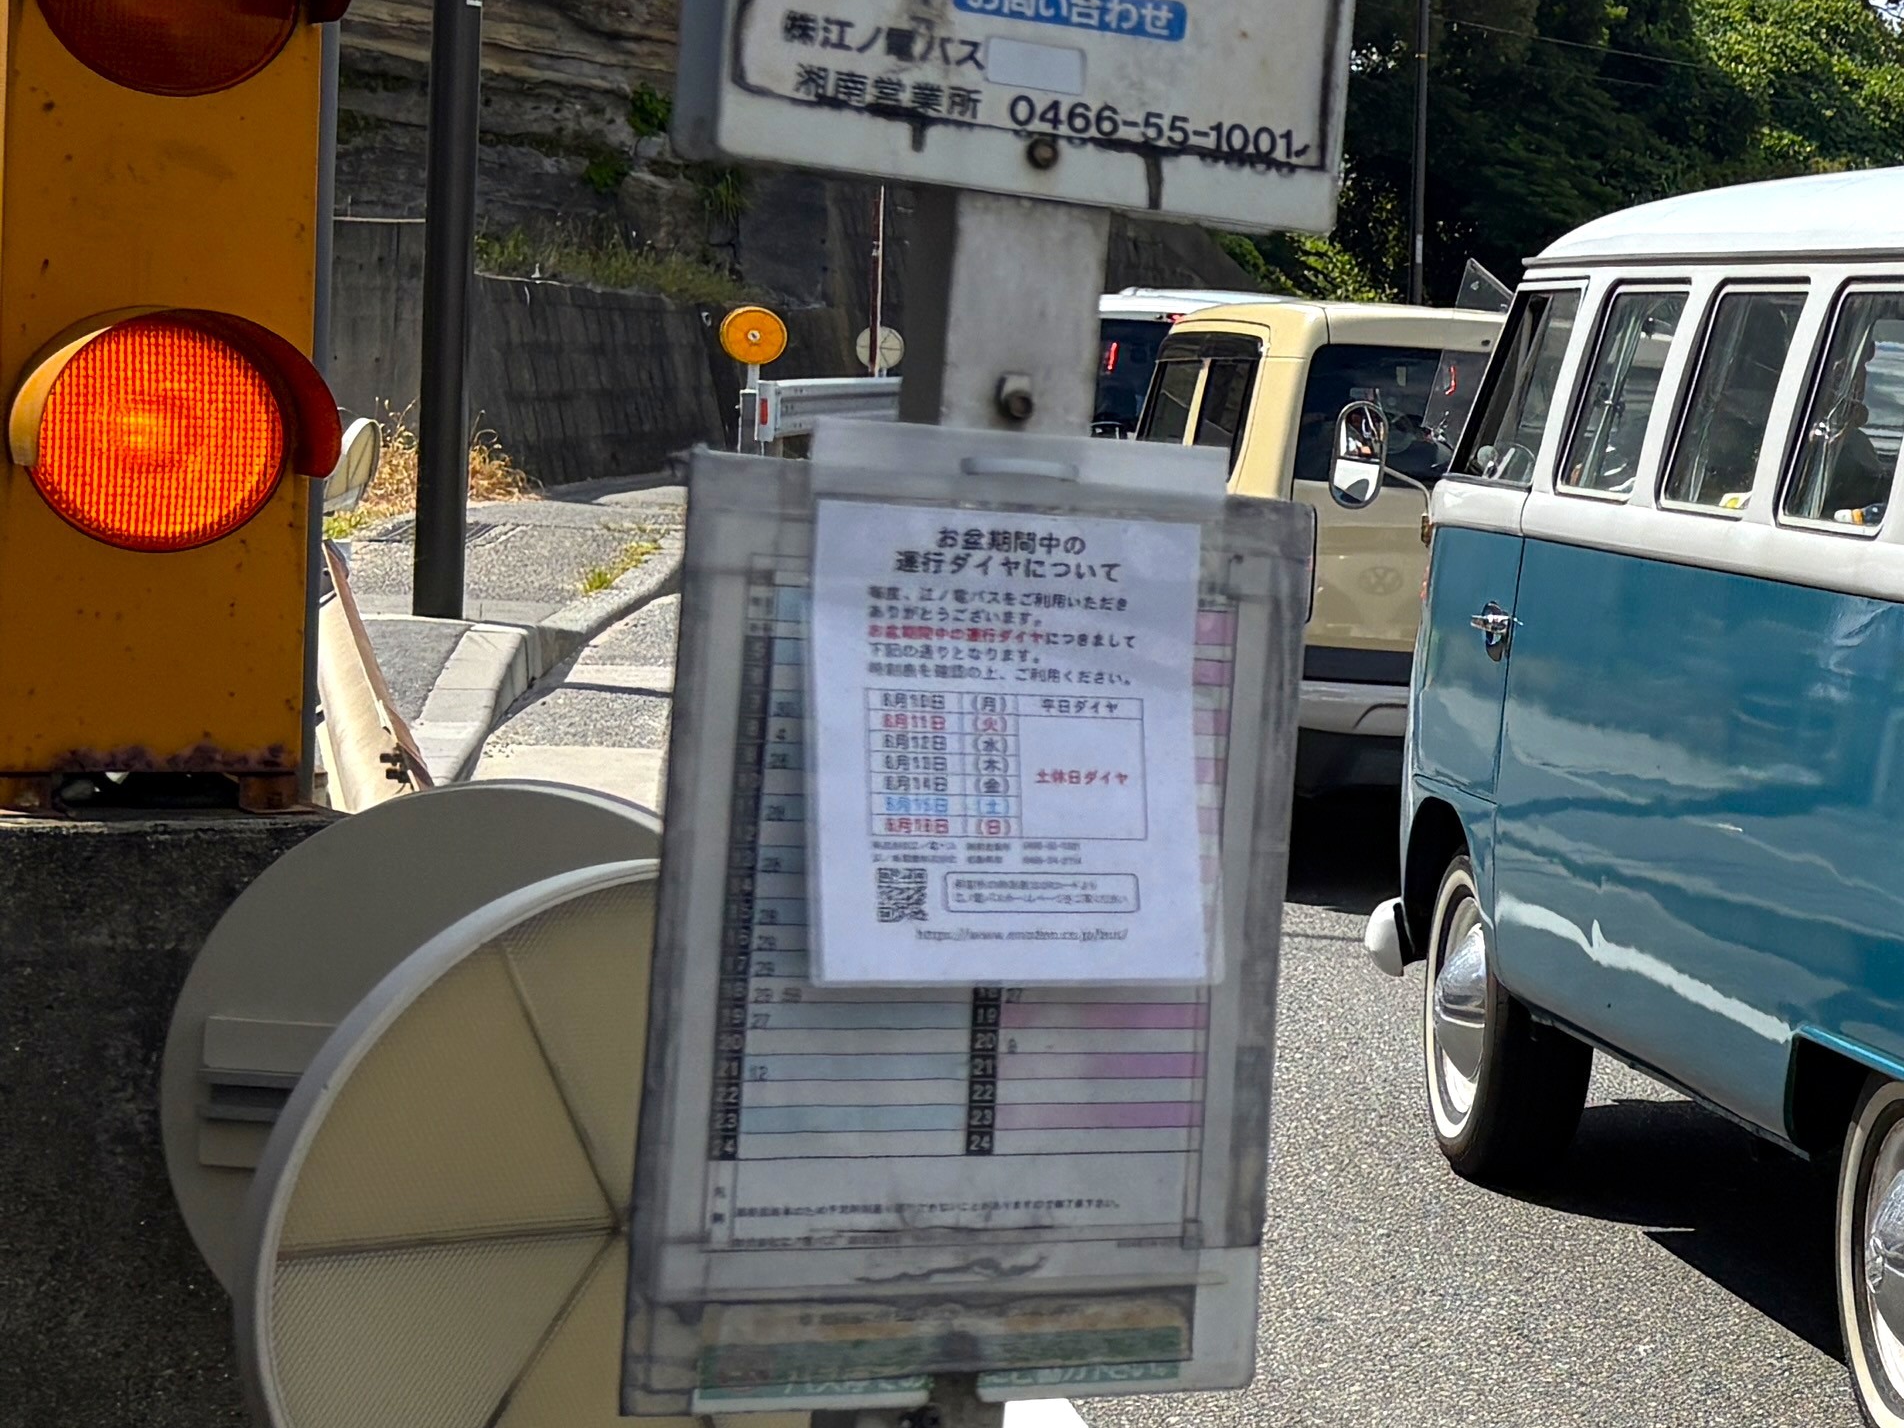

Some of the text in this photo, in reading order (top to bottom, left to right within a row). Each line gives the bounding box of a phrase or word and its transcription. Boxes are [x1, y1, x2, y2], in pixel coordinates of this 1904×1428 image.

[1008, 93, 1296, 160] 0466-55-1001
[936, 526, 1087, 556] お盆期間中の
[895, 550, 1122, 583] 運行ダイヤについて
[1040, 698, 1120, 714] 平日ダイヤ
[1035, 769, 1130, 786] 土休日ダイヤ
[976, 1008, 998, 1024] 19
[974, 1032, 997, 1050] 20
[973, 1058, 993, 1075] 21
[971, 1084, 994, 1100] 22
[970, 1109, 993, 1126] 23
[969, 1134, 992, 1151] 24
